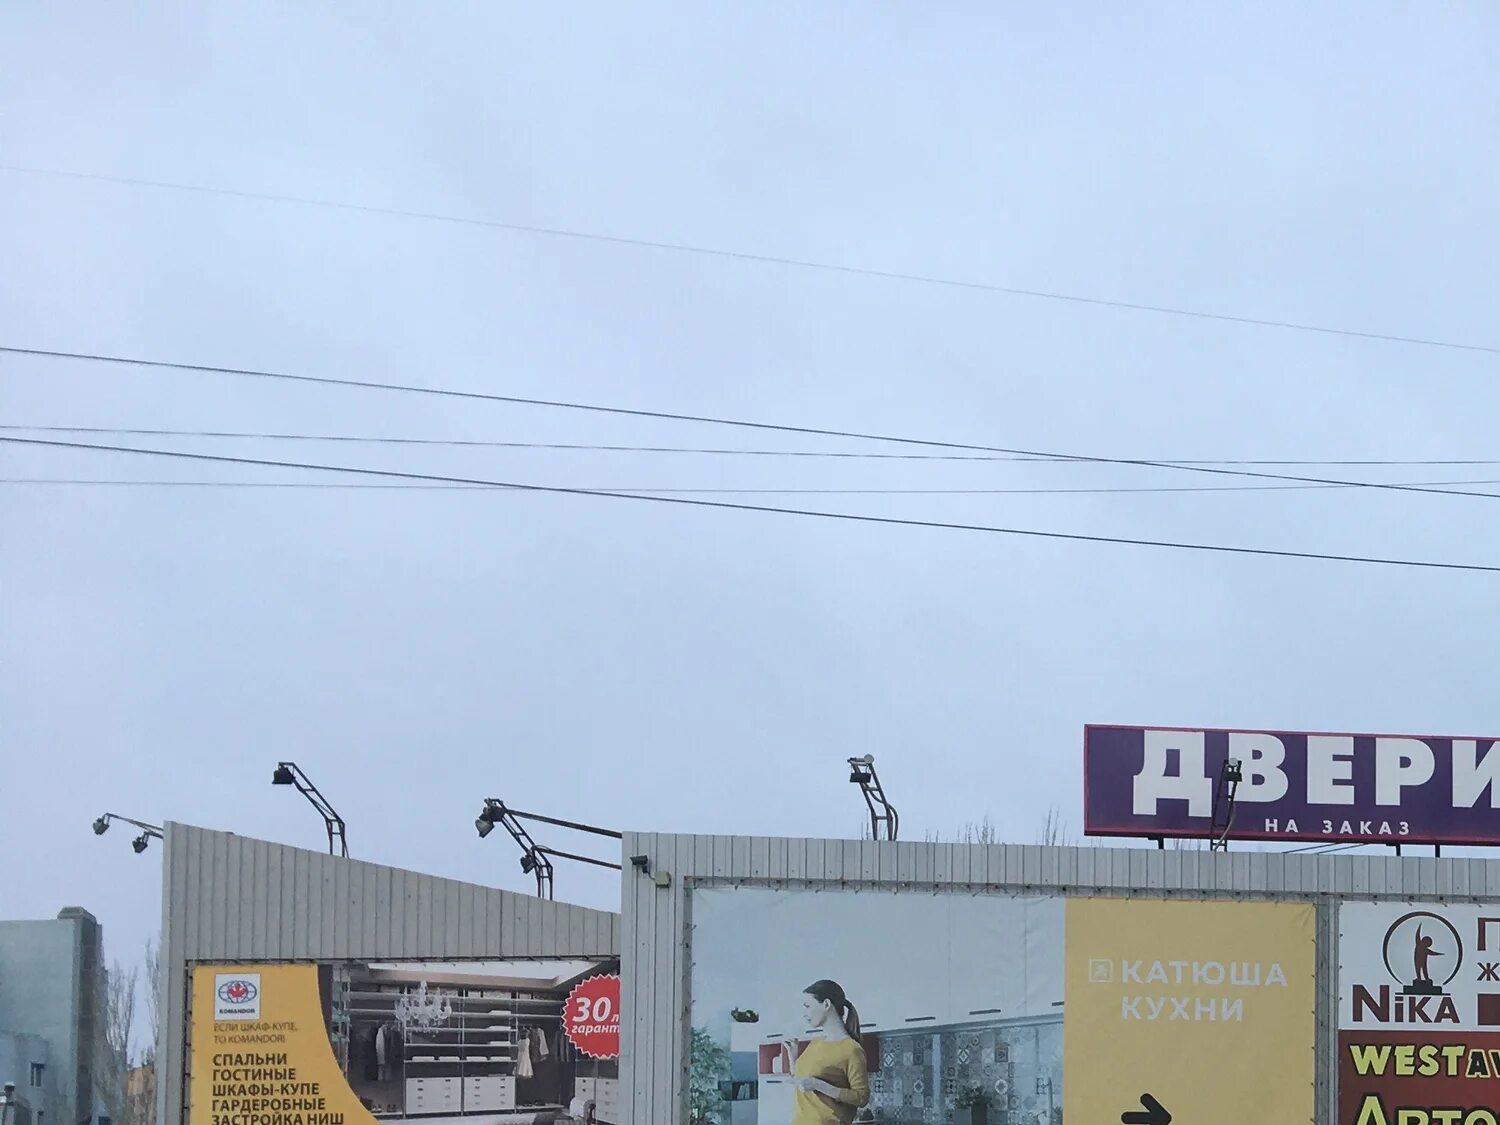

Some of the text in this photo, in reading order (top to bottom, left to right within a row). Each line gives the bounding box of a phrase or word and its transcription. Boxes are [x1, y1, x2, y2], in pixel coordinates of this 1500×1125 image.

[1265, 819, 1410, 836] НА ЗАКАЗ
[1121, 960, 1289, 987] КАТЮША
[572, 996, 611, 1022] 30
[1121, 996, 1244, 1022] КУХНИ
[213, 1022, 238, 1032] ЕСЛИ
[214, 1035, 227, 1044] ТО
[212, 1053, 287, 1067] СПАЛЬНИ
[212, 1068, 296, 1082] ГОСТИНЫЕ
[212, 1083, 319, 1097] ШКАФЫ-КУПЕ
[212, 1098, 326, 1114] ГАРДЕРОБНЫЕ
[307, 1113, 344, 1125] НИШ
